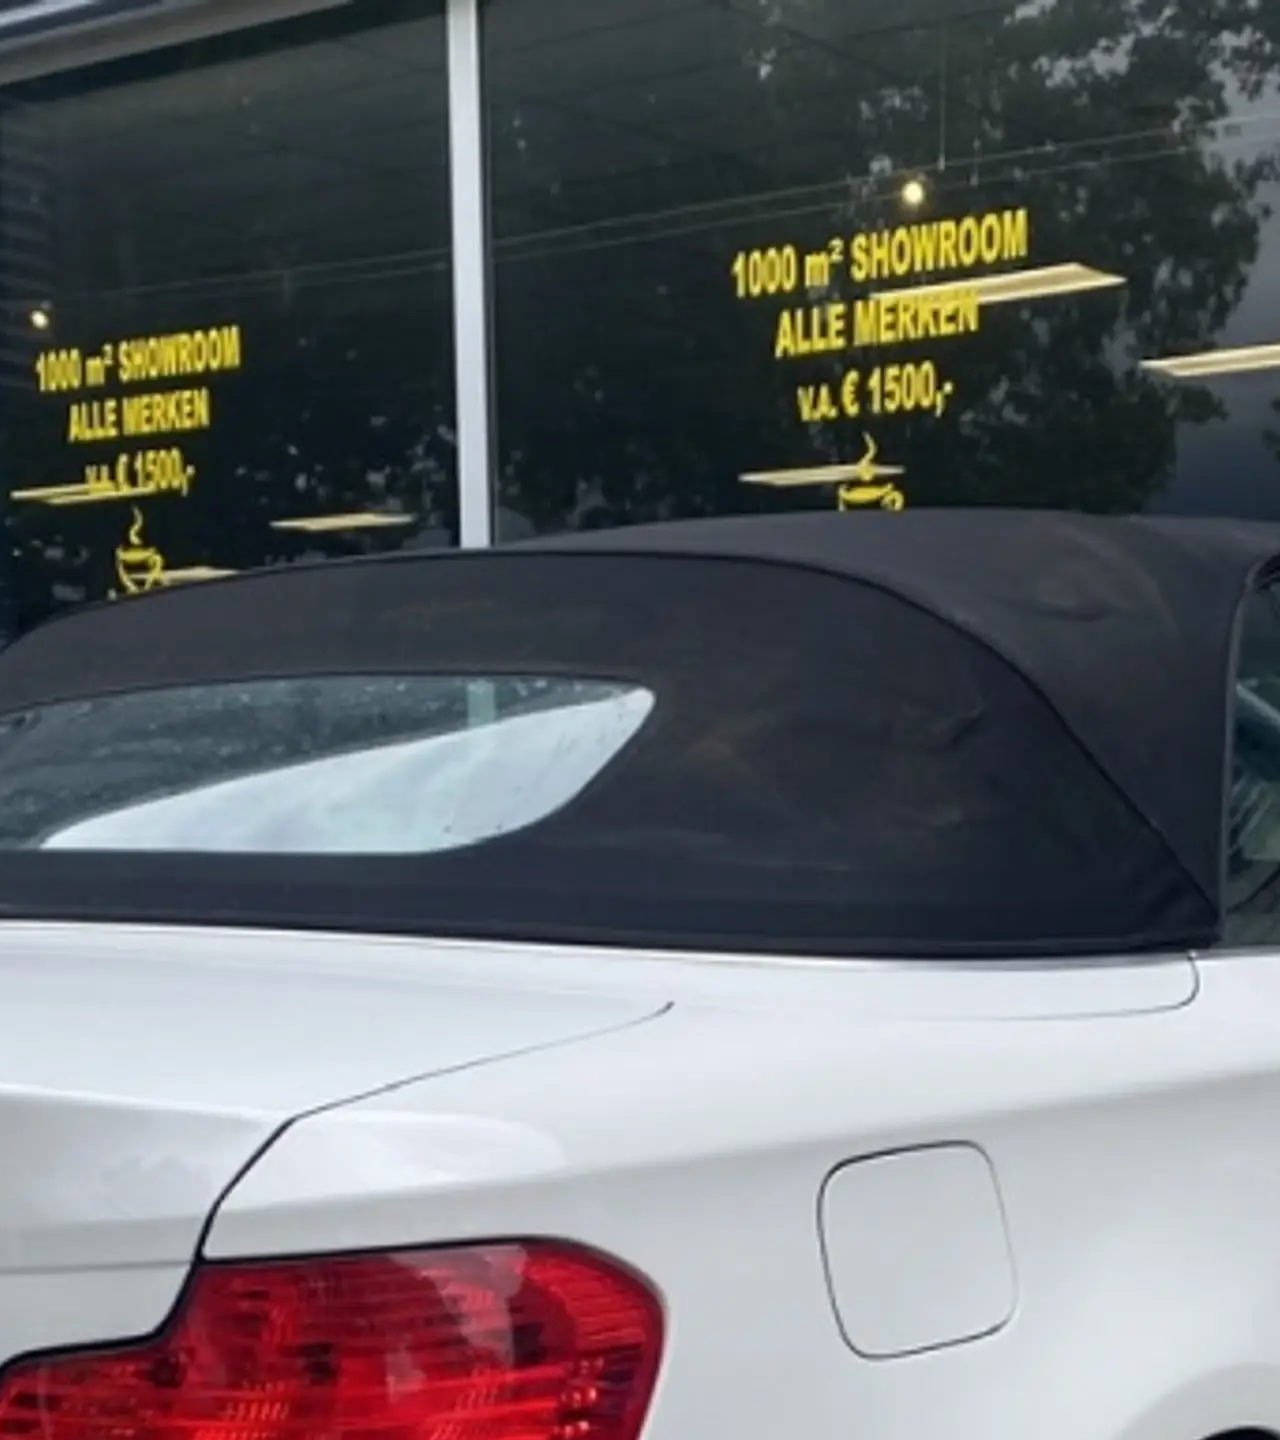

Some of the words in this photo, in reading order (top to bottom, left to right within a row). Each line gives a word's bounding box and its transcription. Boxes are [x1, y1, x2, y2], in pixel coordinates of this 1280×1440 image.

[731, 244, 797, 298] 1000
[850, 206, 1029, 283] SHOWROOM
[774, 303, 847, 359] ALLE
[853, 287, 980, 348] MERKEN
[36, 348, 82, 392] 1000
[118, 324, 240, 383] SHOWROOM
[841, 369, 861, 417] €
[867, 359, 954, 419] 1500,-
[68, 398, 118, 442] ALLE
[122, 386, 210, 436] MERKEN
